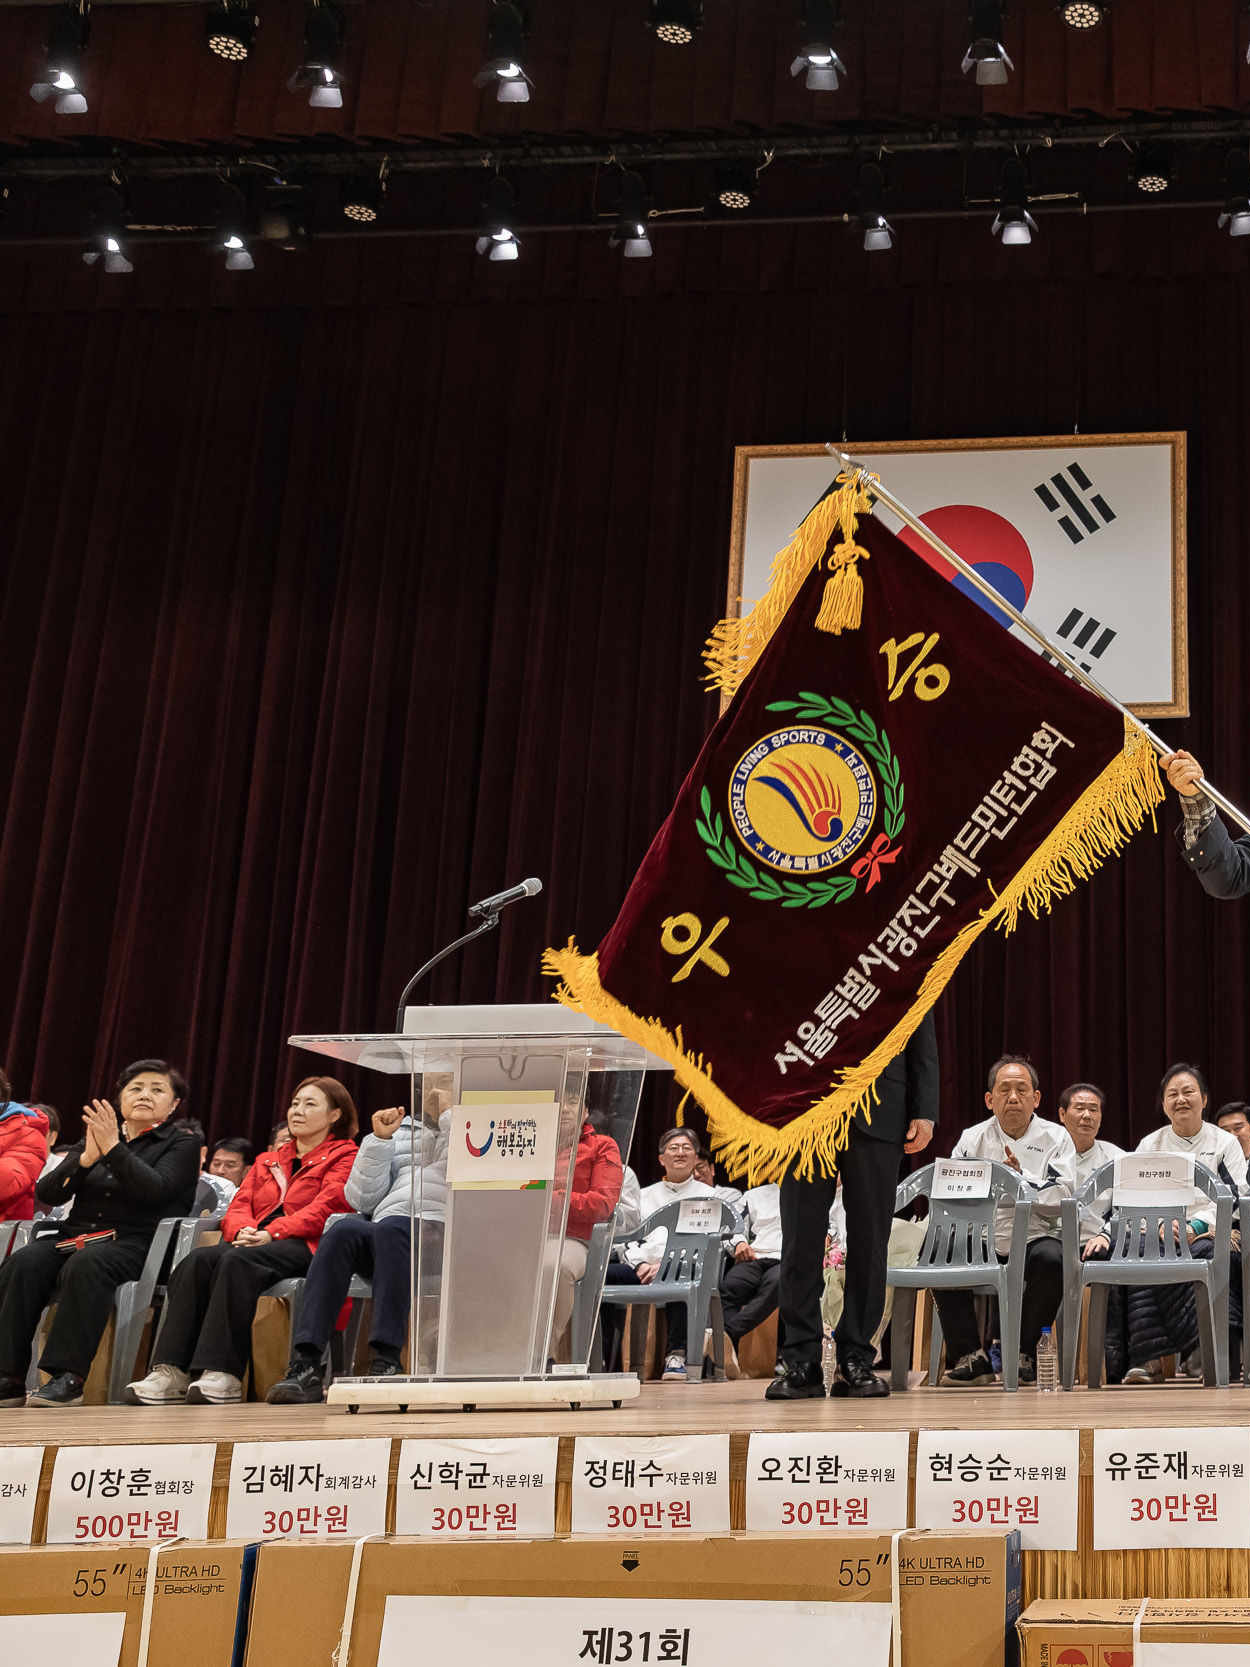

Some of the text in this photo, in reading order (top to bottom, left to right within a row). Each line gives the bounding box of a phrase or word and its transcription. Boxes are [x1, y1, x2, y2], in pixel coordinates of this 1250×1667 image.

[732, 730, 826, 837] PEOPLE LIVING SPORTS
[660, 631, 951, 983] 우 승
[774, 721, 1075, 1075] 서울특별시광진구배드민턴협회
[496, 1132, 537, 1157] 행복광진
[941, 1168, 983, 1178] 광진구협회장
[1138, 1170, 1172, 1178] 광진구청장
[263, 1505, 347, 1534] 30만원
[432, 1504, 516, 1531] 30만원
[608, 1501, 691, 1528] 30만원
[782, 1498, 868, 1525] 30만원
[953, 1496, 1038, 1524] 30만원
[1131, 1494, 1217, 1522] 30만원
[76, 1510, 179, 1538] 500만원
[156, 1565, 198, 1579] ULTRA
[201, 1564, 221, 1577] HD
[899, 1556, 985, 1569] 4K ULTRA HD
[164, 1583, 225, 1596] Backlight
[930, 1575, 991, 1587] Backlight
[579, 1627, 690, 1666] 제31회
[1040, 1643, 1049, 1660] MADE
